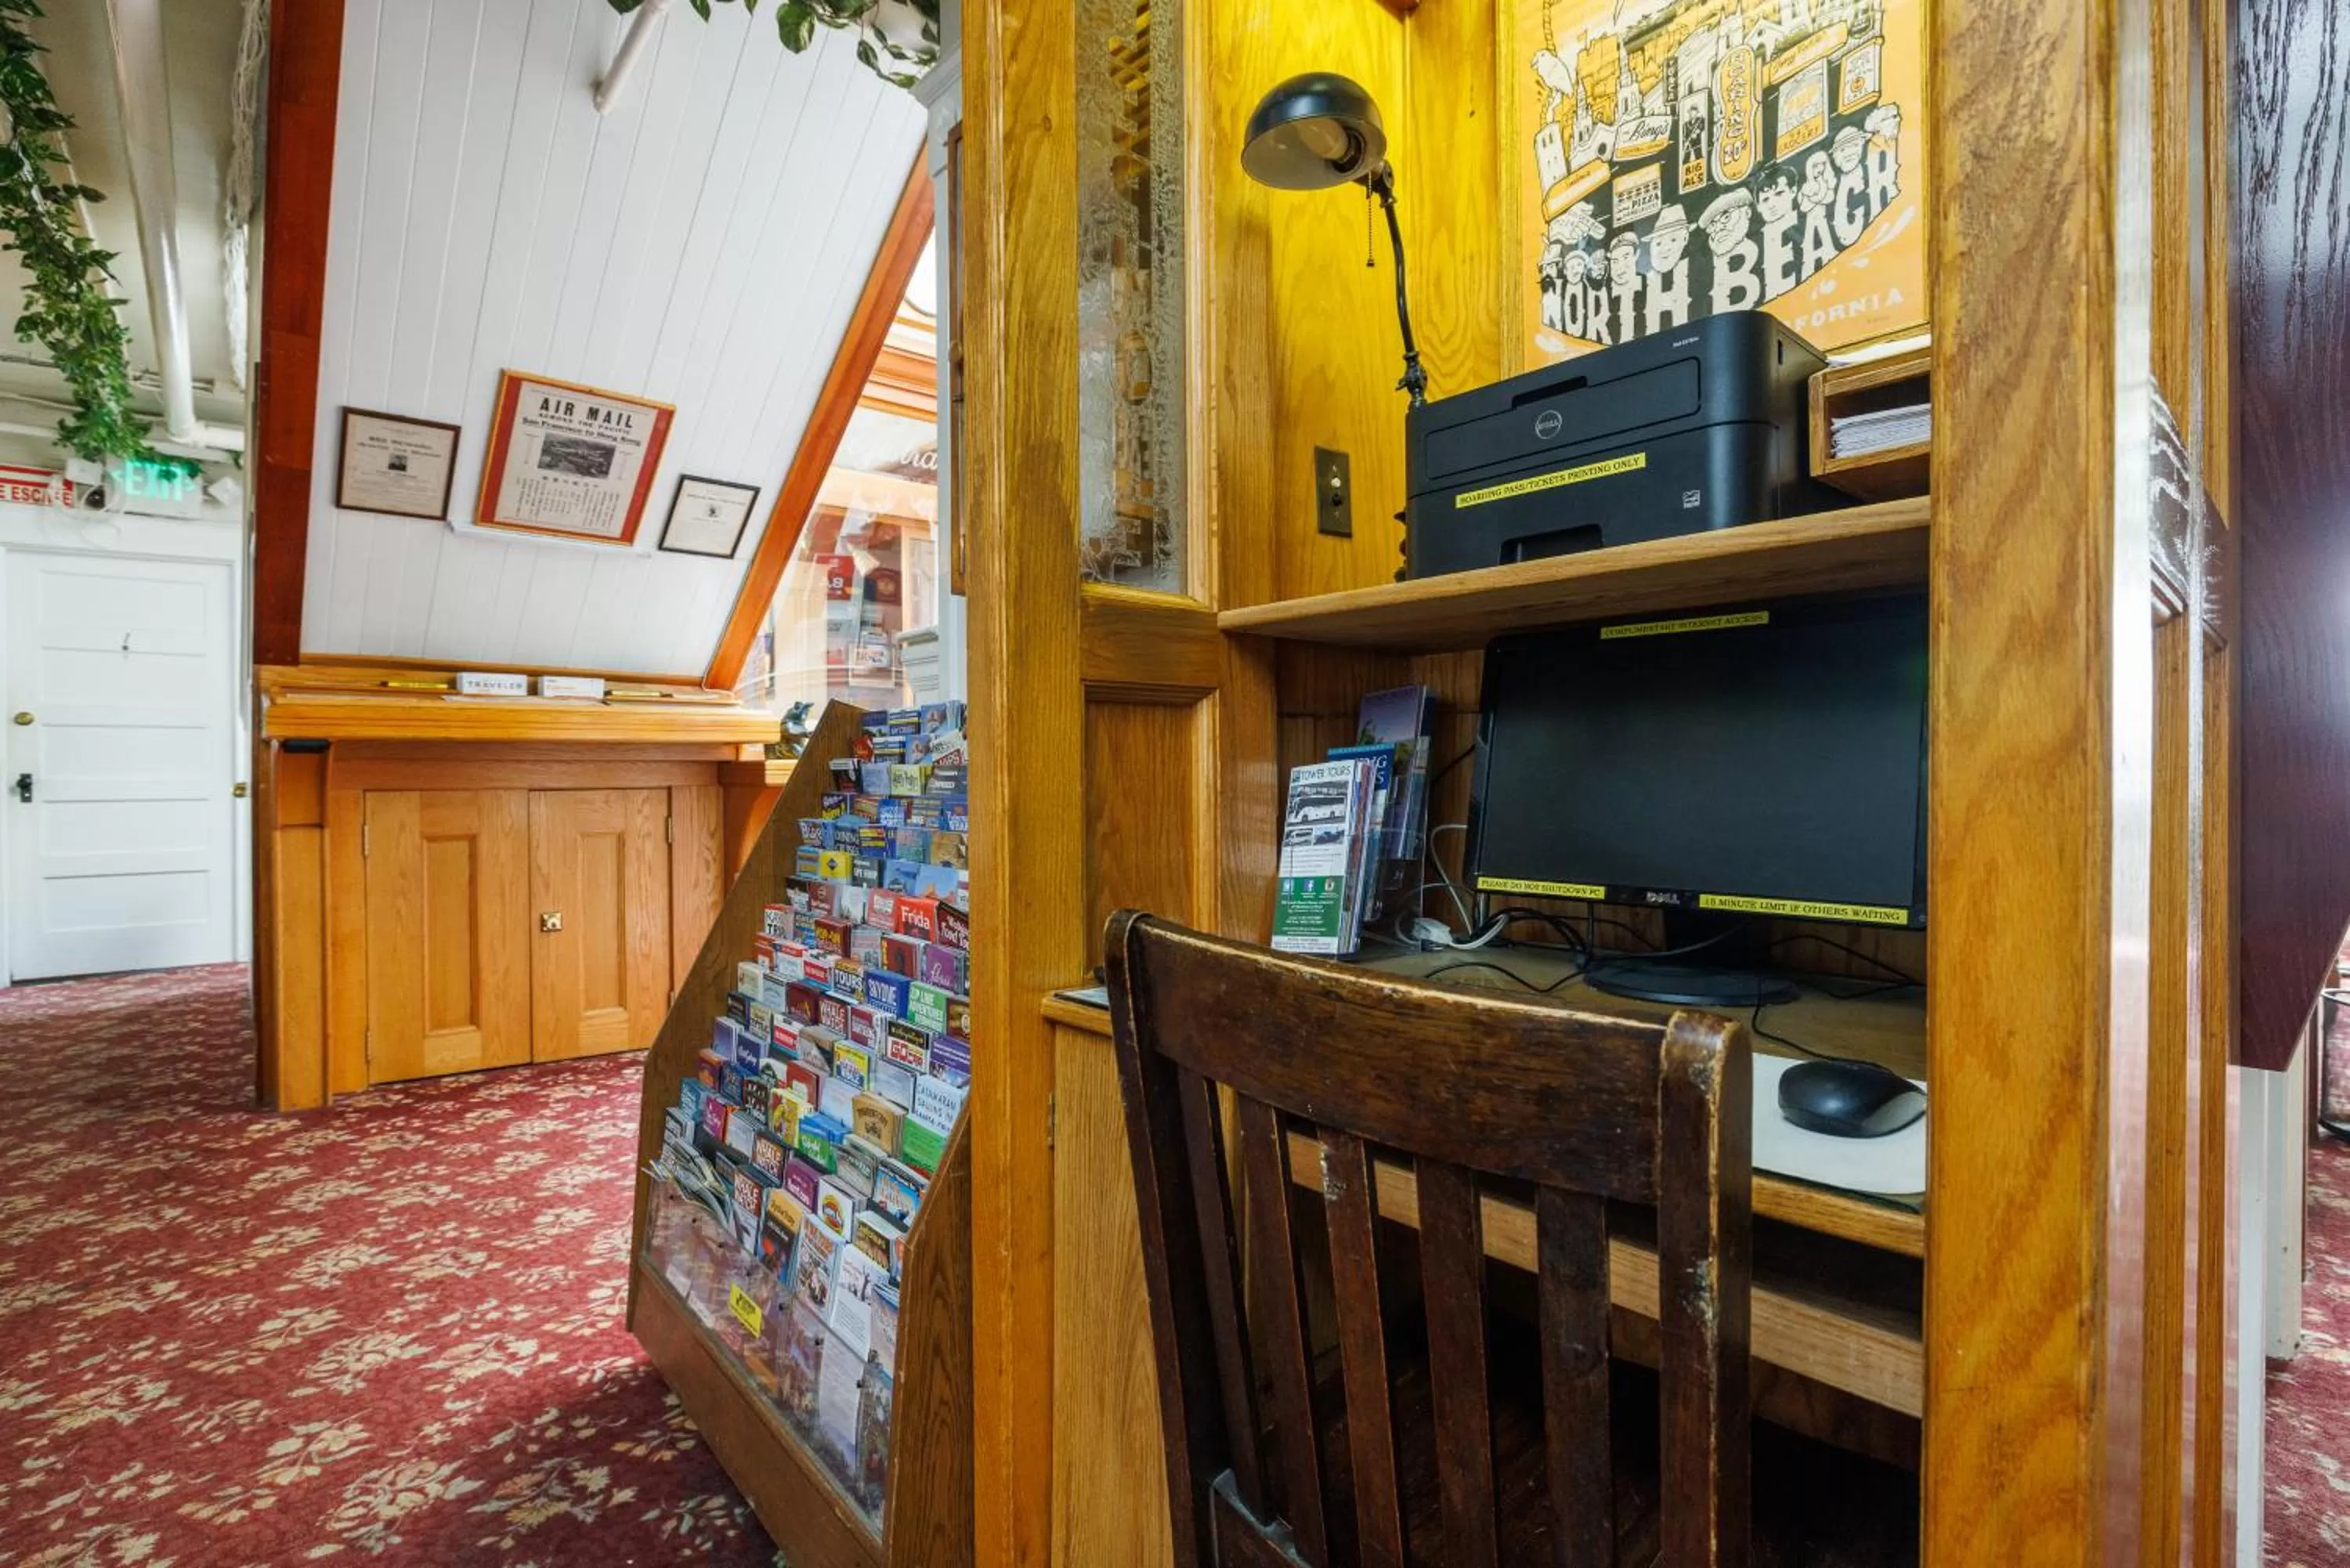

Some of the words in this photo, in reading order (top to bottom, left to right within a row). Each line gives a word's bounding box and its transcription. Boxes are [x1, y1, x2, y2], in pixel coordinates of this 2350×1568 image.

[1684, 162, 1703, 175] BIG
[1632, 193, 1659, 209] PIZZA
[1541, 265, 1689, 346] NORTH
[1710, 135, 1901, 314] BEACH
[1784, 287, 1904, 333] FORNIA
[540, 397, 575, 417] AIR
[586, 406, 633, 428] MAIL
[1567, 464, 1611, 480] PRINTING
[1613, 457, 1640, 471] ONLY
[125, 461, 183, 502] EXIT
[1301, 768, 1325, 781] TOWER
[1328, 765, 1351, 778] TOURS
[1481, 880, 1509, 889] PLEASE
[1510, 881, 1522, 890] DO
[1542, 884, 1587, 895] SHUTDOWN
[1647, 891, 1680, 904] DELL
[901, 905, 930, 930] Frida
[1719, 898, 1756, 909] MINUTE
[1759, 901, 1786, 912] LIMIT
[1789, 904, 1802, 913] IF
[1803, 905, 1849, 916] OTHERS
[1851, 907, 1900, 921] WAITING
[835, 969, 862, 991] TOURS
